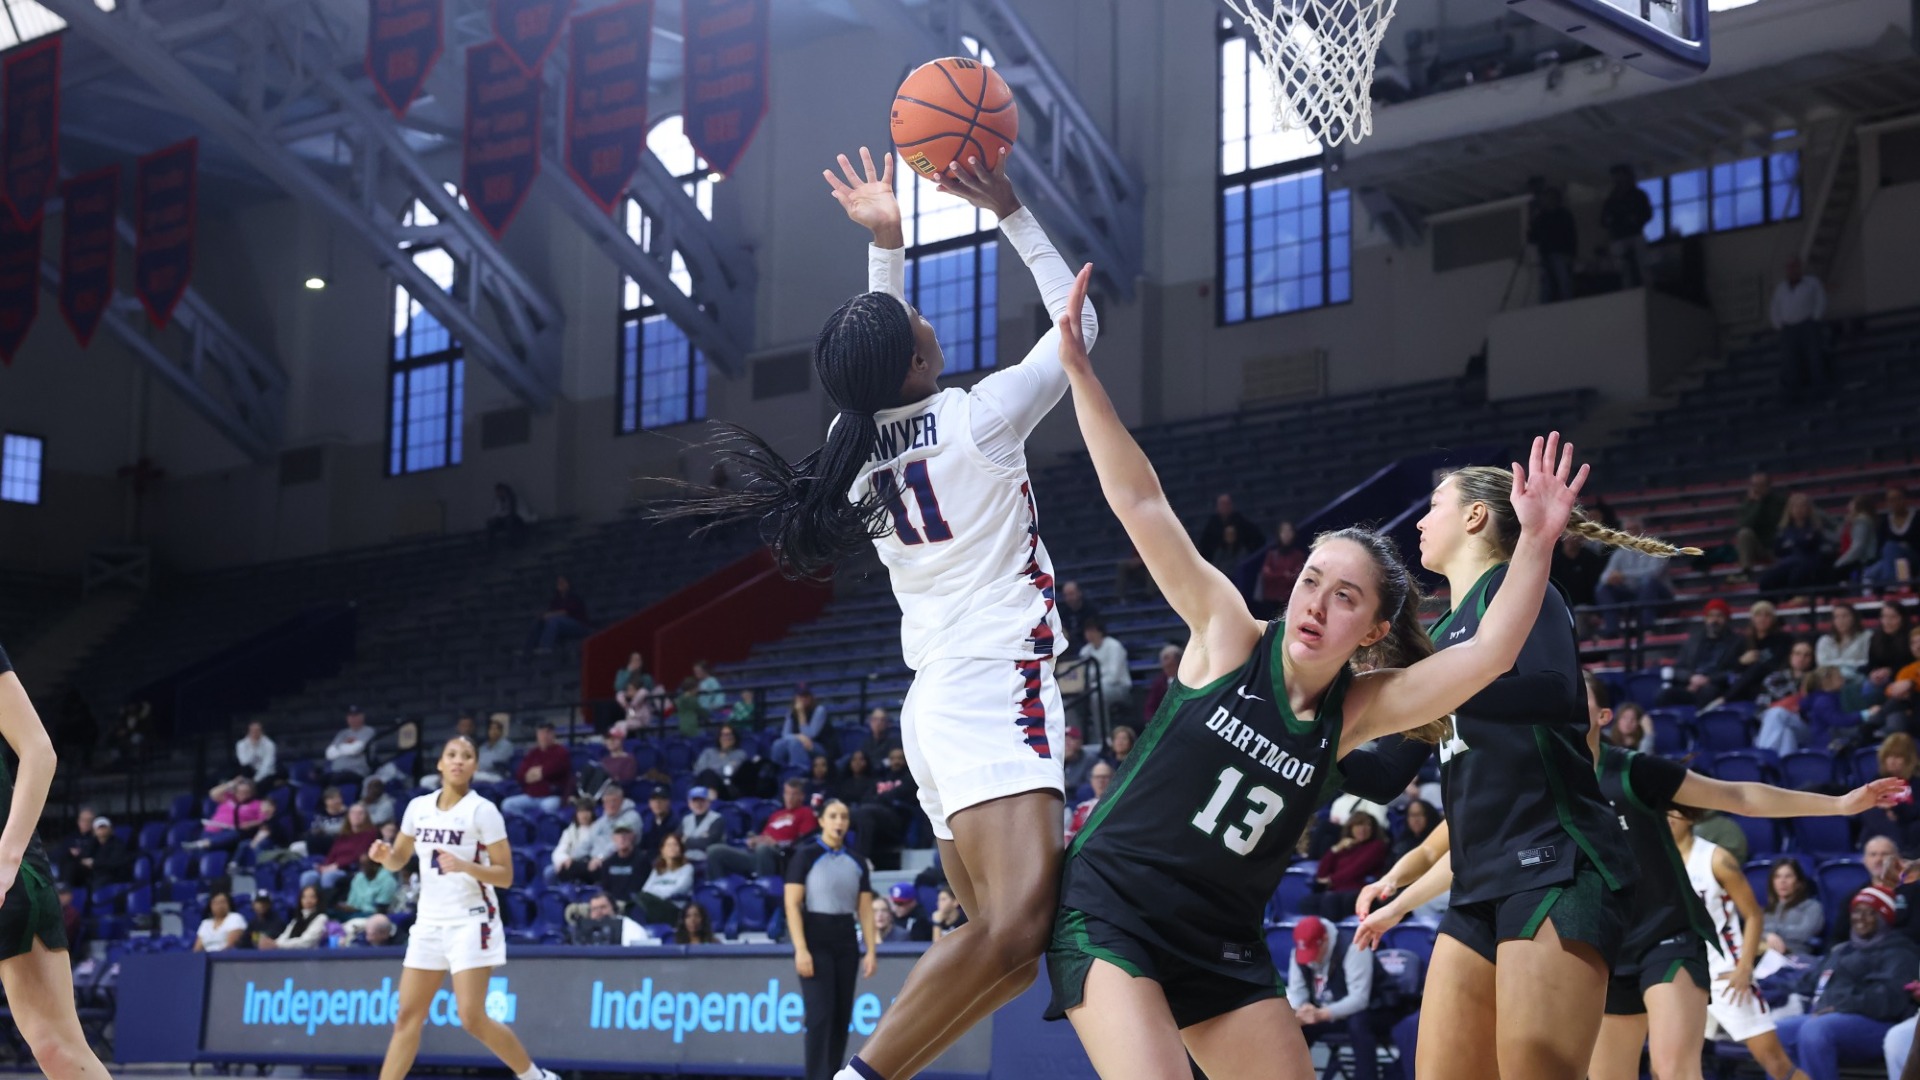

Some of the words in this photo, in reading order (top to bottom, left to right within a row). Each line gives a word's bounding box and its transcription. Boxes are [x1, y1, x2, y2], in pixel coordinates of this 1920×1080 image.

[873, 458, 954, 546] 11
[414, 828, 465, 846] PENN
[1191, 767, 1285, 857] 13
[243, 977, 464, 1037] Independece
[590, 977, 883, 1044] Independee
